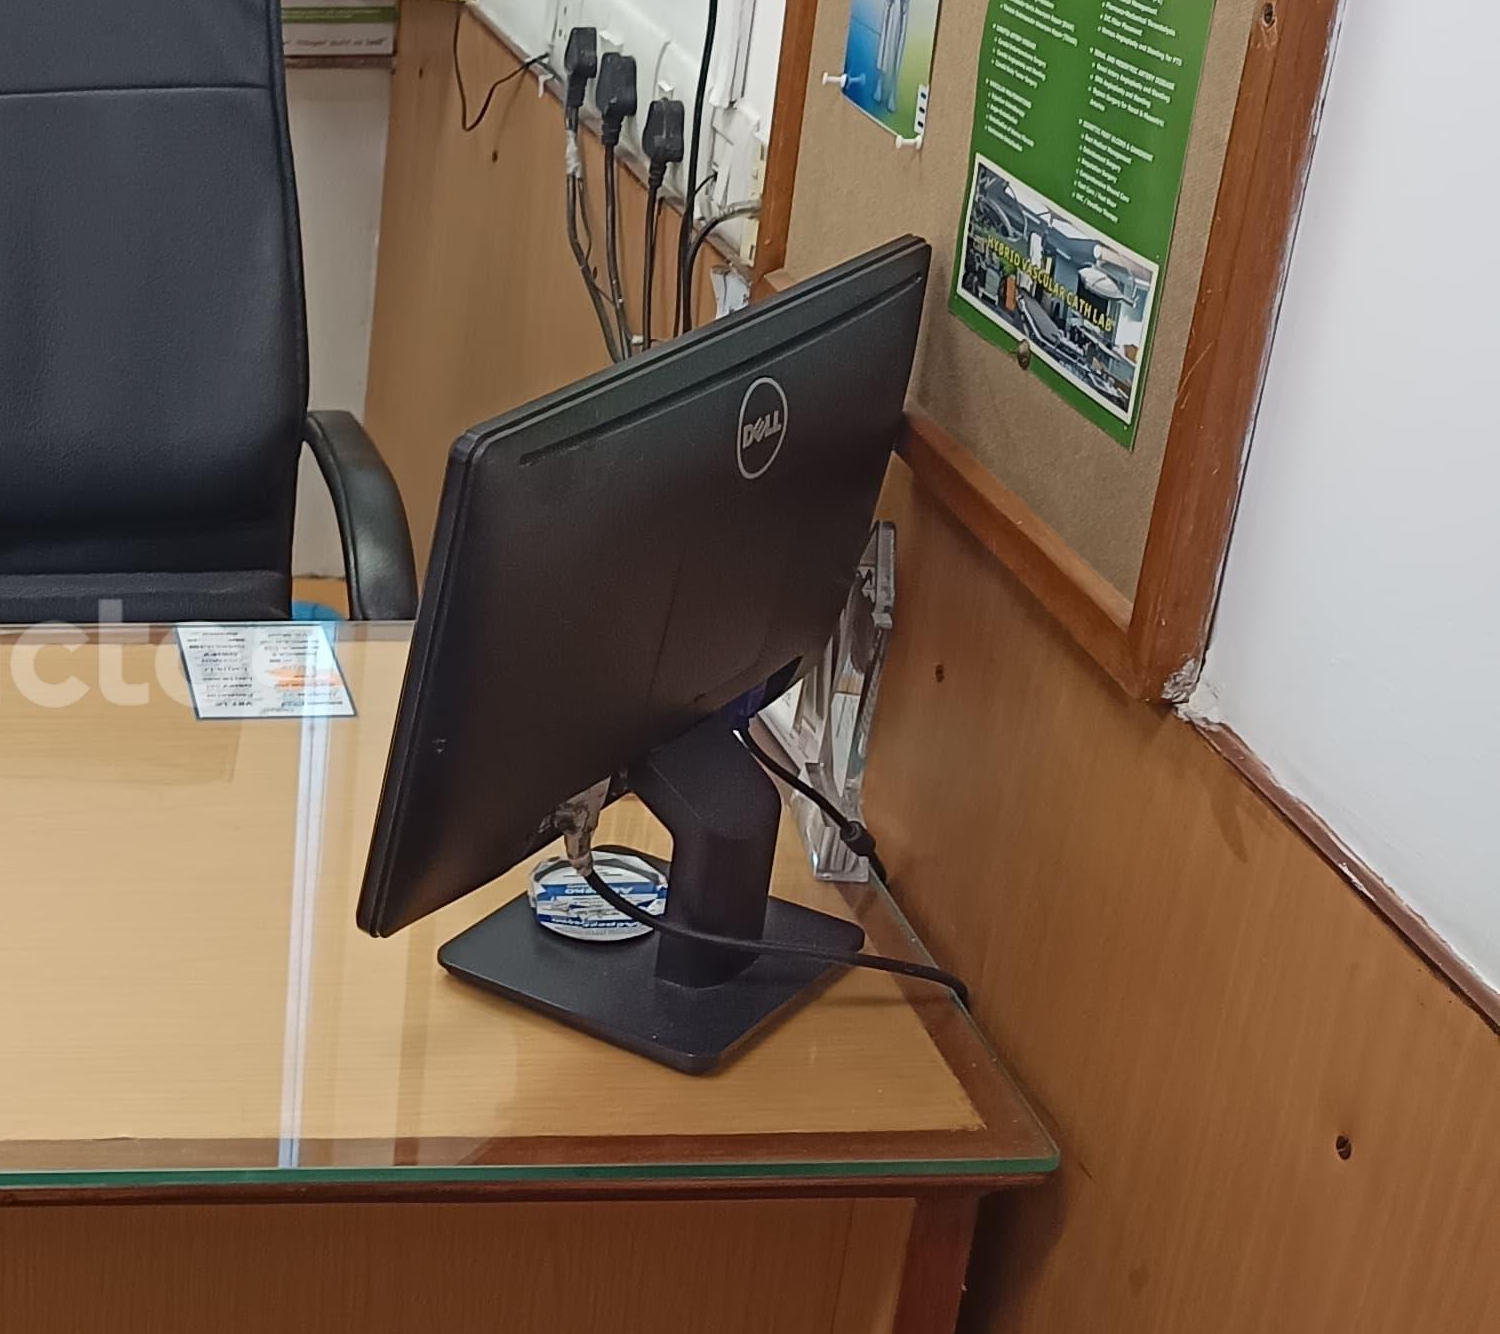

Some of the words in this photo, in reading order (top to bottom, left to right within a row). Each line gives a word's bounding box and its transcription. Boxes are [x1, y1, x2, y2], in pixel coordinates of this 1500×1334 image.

[987, 235, 1020, 267] HYBRID
[1021, 258, 1066, 300] VASCULAR
[1066, 291, 1092, 319] CATH
[1092, 307, 1114, 332] LAB
[742, 410, 782, 450] DELL
